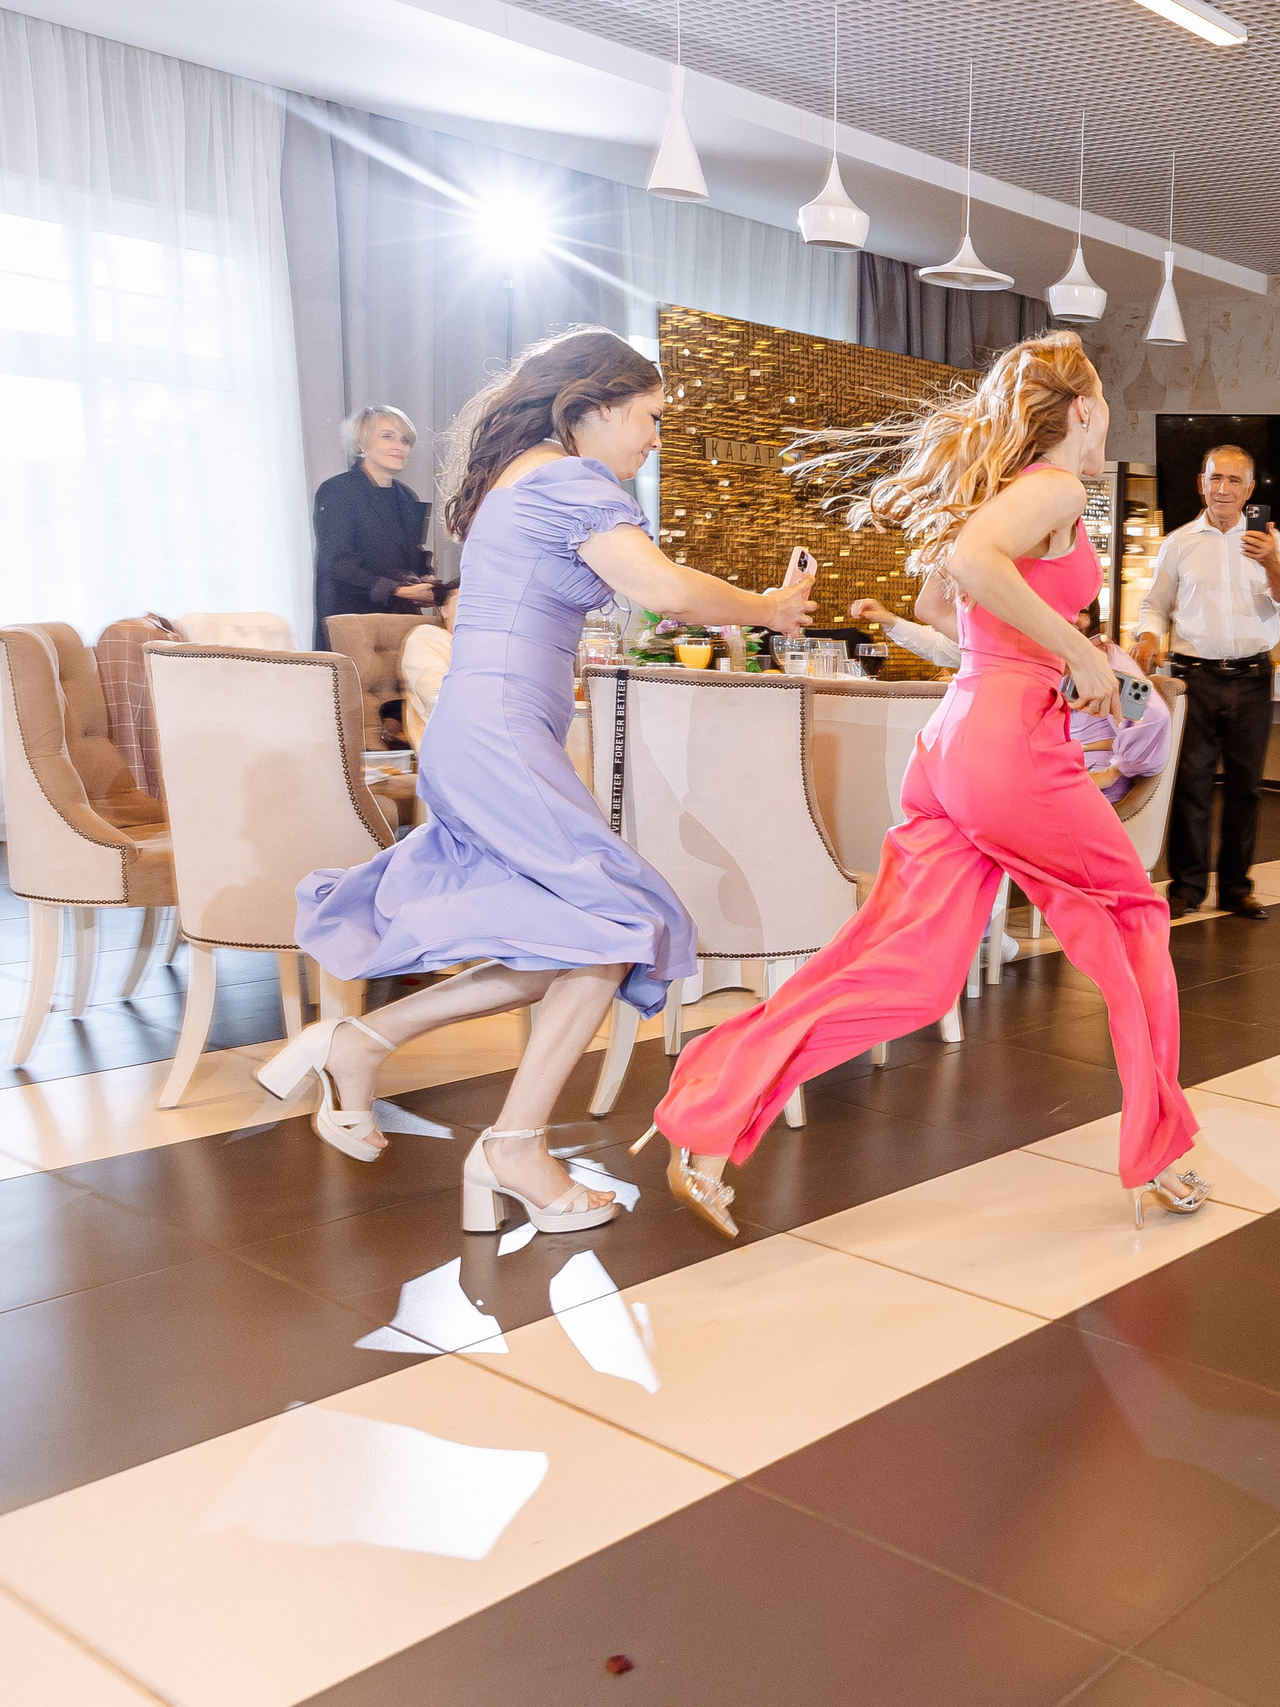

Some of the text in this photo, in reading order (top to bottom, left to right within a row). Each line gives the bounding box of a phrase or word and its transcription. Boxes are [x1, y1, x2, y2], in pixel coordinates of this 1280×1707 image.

[616, 679, 626, 716] BETTER
[614, 719, 625, 764] FOREVER
[612, 773, 622, 810] BETTER
